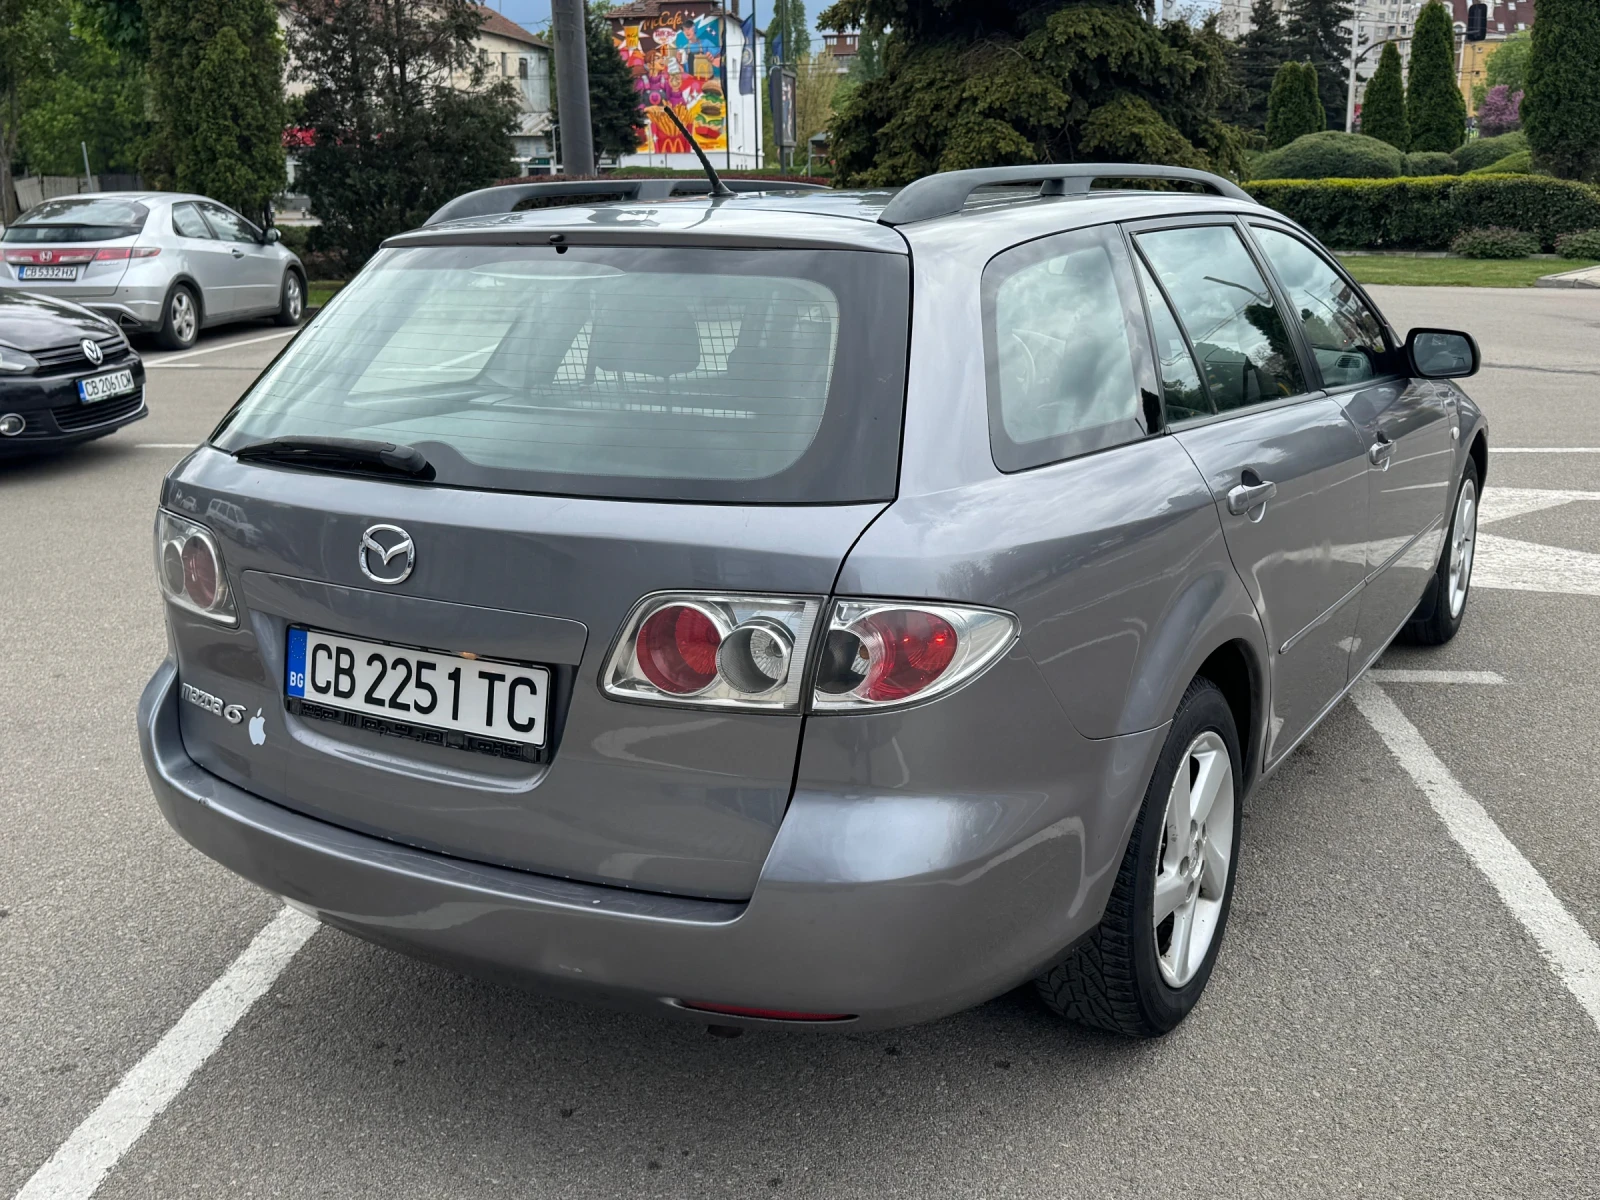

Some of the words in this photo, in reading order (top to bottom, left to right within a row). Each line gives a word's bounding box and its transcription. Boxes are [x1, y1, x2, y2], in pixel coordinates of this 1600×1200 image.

[25, 267, 37, 278] CB
[62, 267, 74, 278] HX
[85, 380, 100, 397] CB
[99, 375, 122, 393] 2061
[290, 671, 304, 689] BG
[311, 643, 356, 699] CB
[364, 653, 462, 721] 2251
[479, 671, 538, 733] TC
